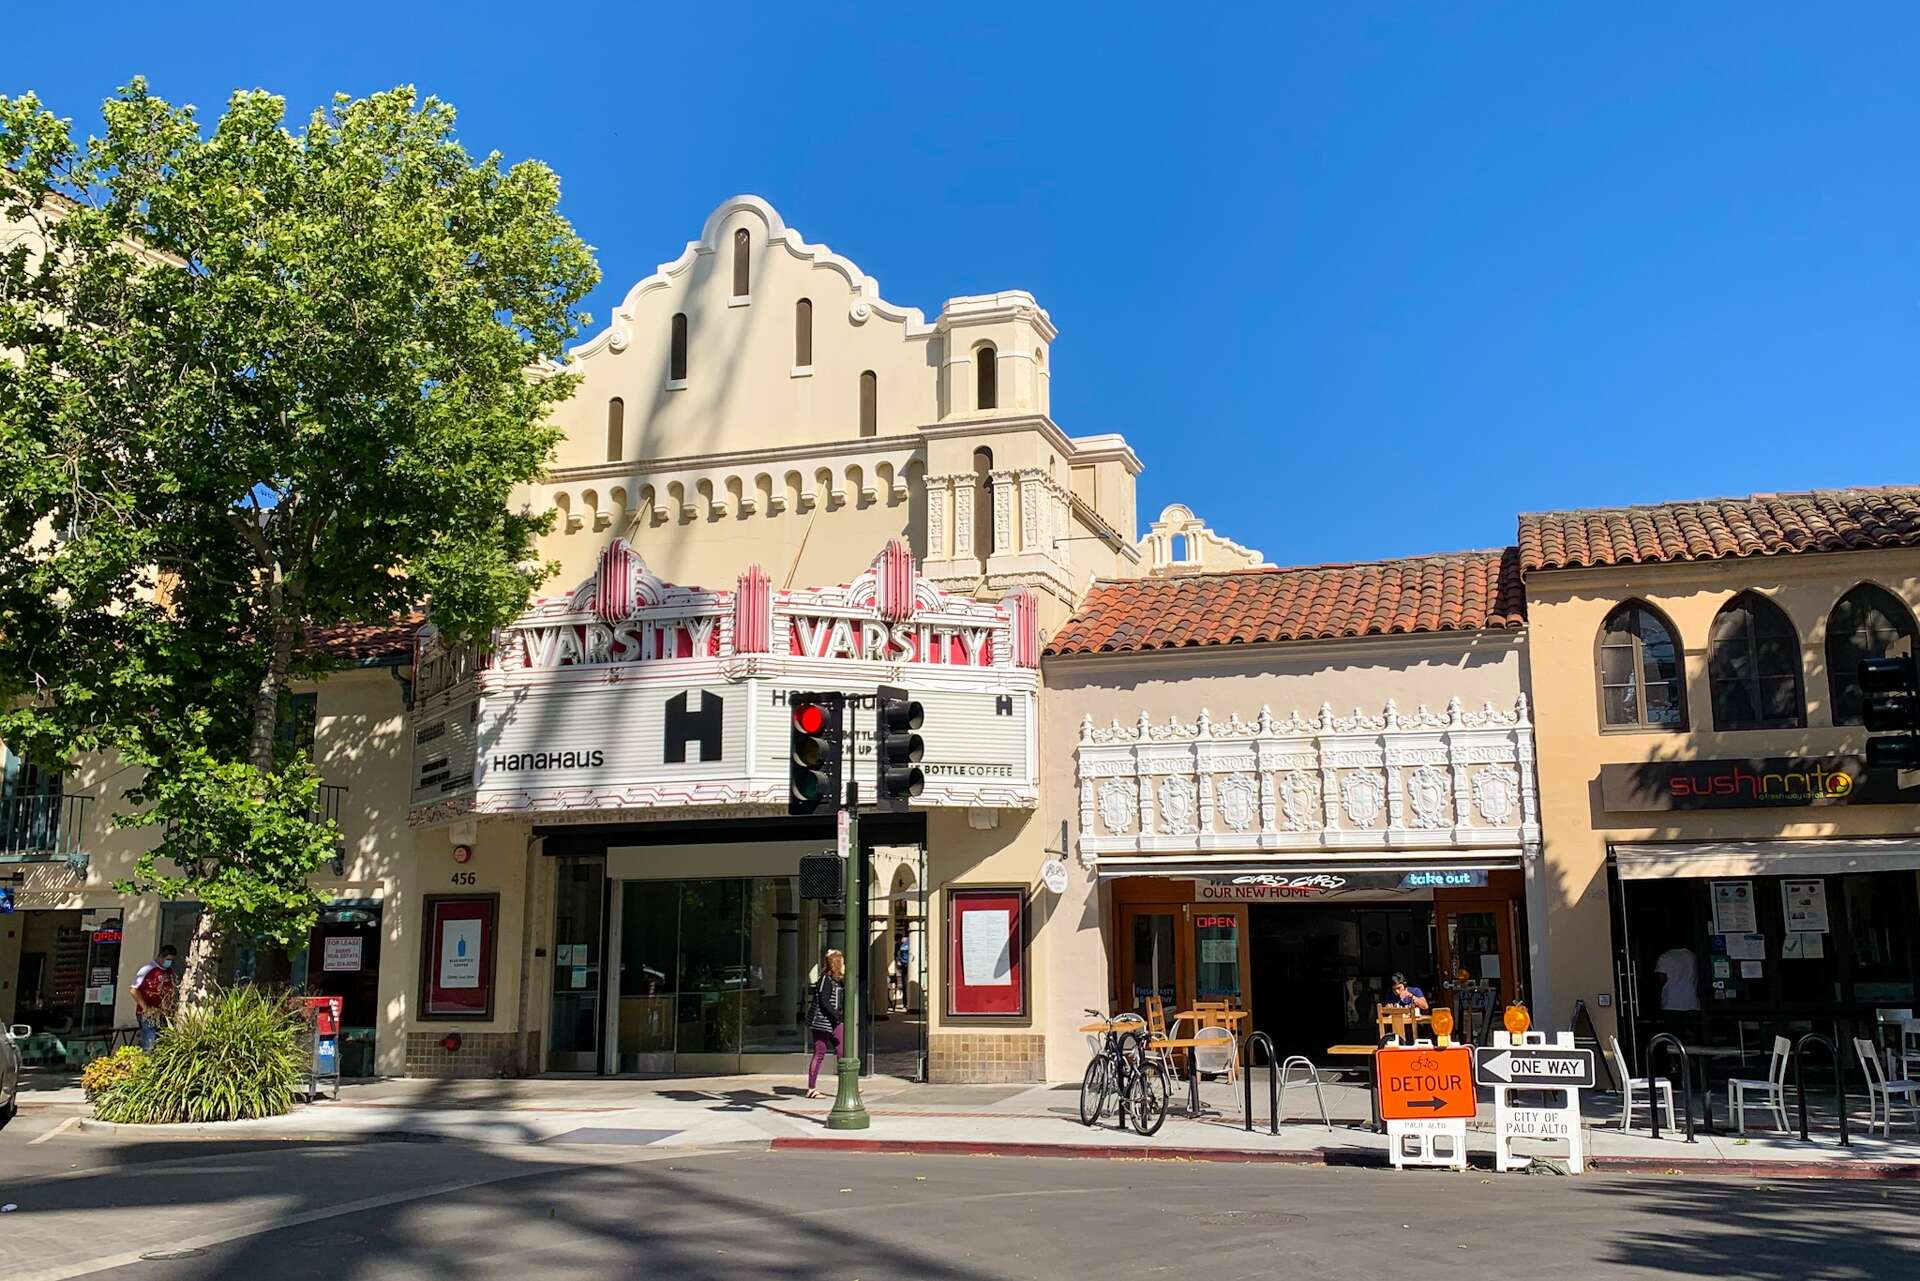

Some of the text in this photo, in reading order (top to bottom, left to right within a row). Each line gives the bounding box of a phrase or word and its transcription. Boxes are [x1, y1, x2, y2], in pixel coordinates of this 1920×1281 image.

[523, 615, 716, 668] VARSITY
[795, 615, 990, 666] VARSITY
[859, 745, 872, 754] UP
[924, 765, 965, 775] BOTTLE
[968, 767, 1012, 777] COFFEE
[1668, 764, 1853, 798] sushirrito
[451, 872, 476, 885] 456
[1410, 872, 1471, 884] take out
[1203, 887, 1310, 898] OUR NEW HOME
[1196, 917, 1236, 928] OPEN
[93, 931, 122, 941] OPEN
[1511, 1060, 1580, 1075] ONE WAY
[1390, 1075, 1462, 1092] DETOUR
[1514, 1112, 1559, 1123] CITY OF
[1506, 1123, 1568, 1135] PALO ALTO
